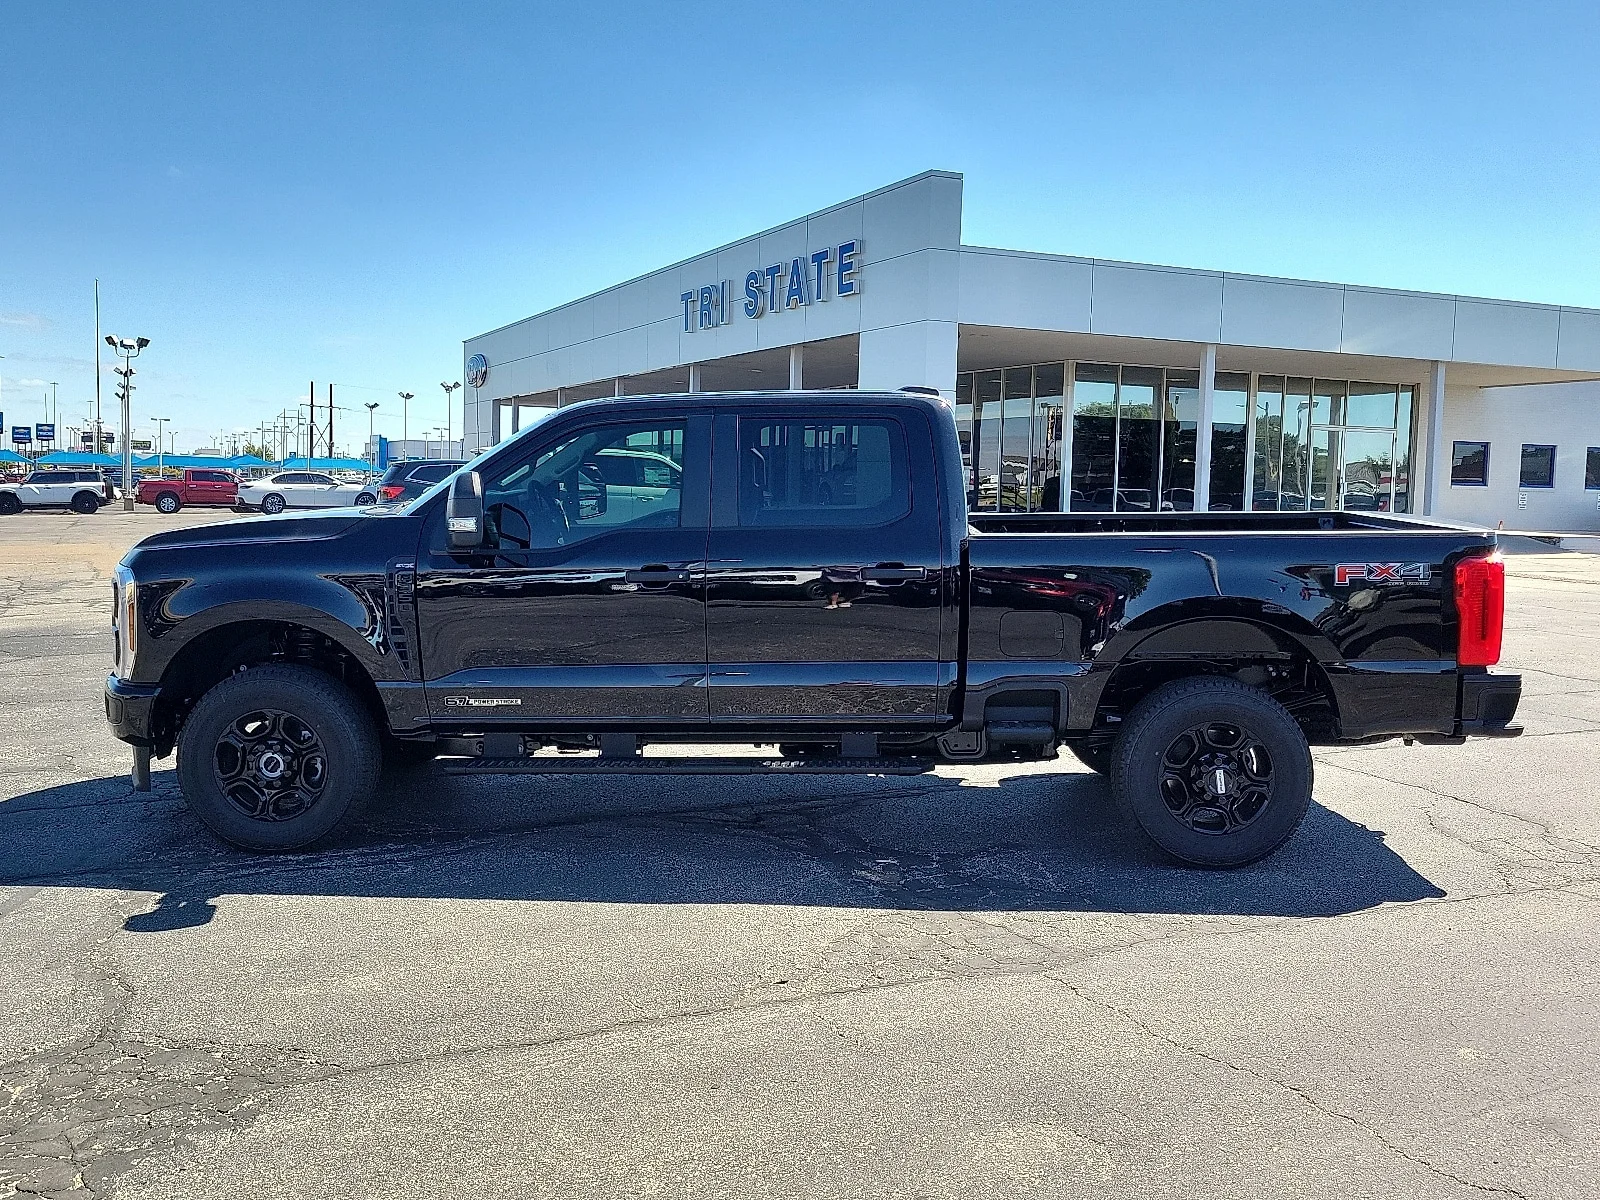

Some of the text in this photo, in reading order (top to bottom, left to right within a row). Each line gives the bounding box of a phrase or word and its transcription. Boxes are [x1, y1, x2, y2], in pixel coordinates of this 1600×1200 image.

[680, 239, 863, 333] TRI STATE
[1335, 563, 1431, 586] FX4
